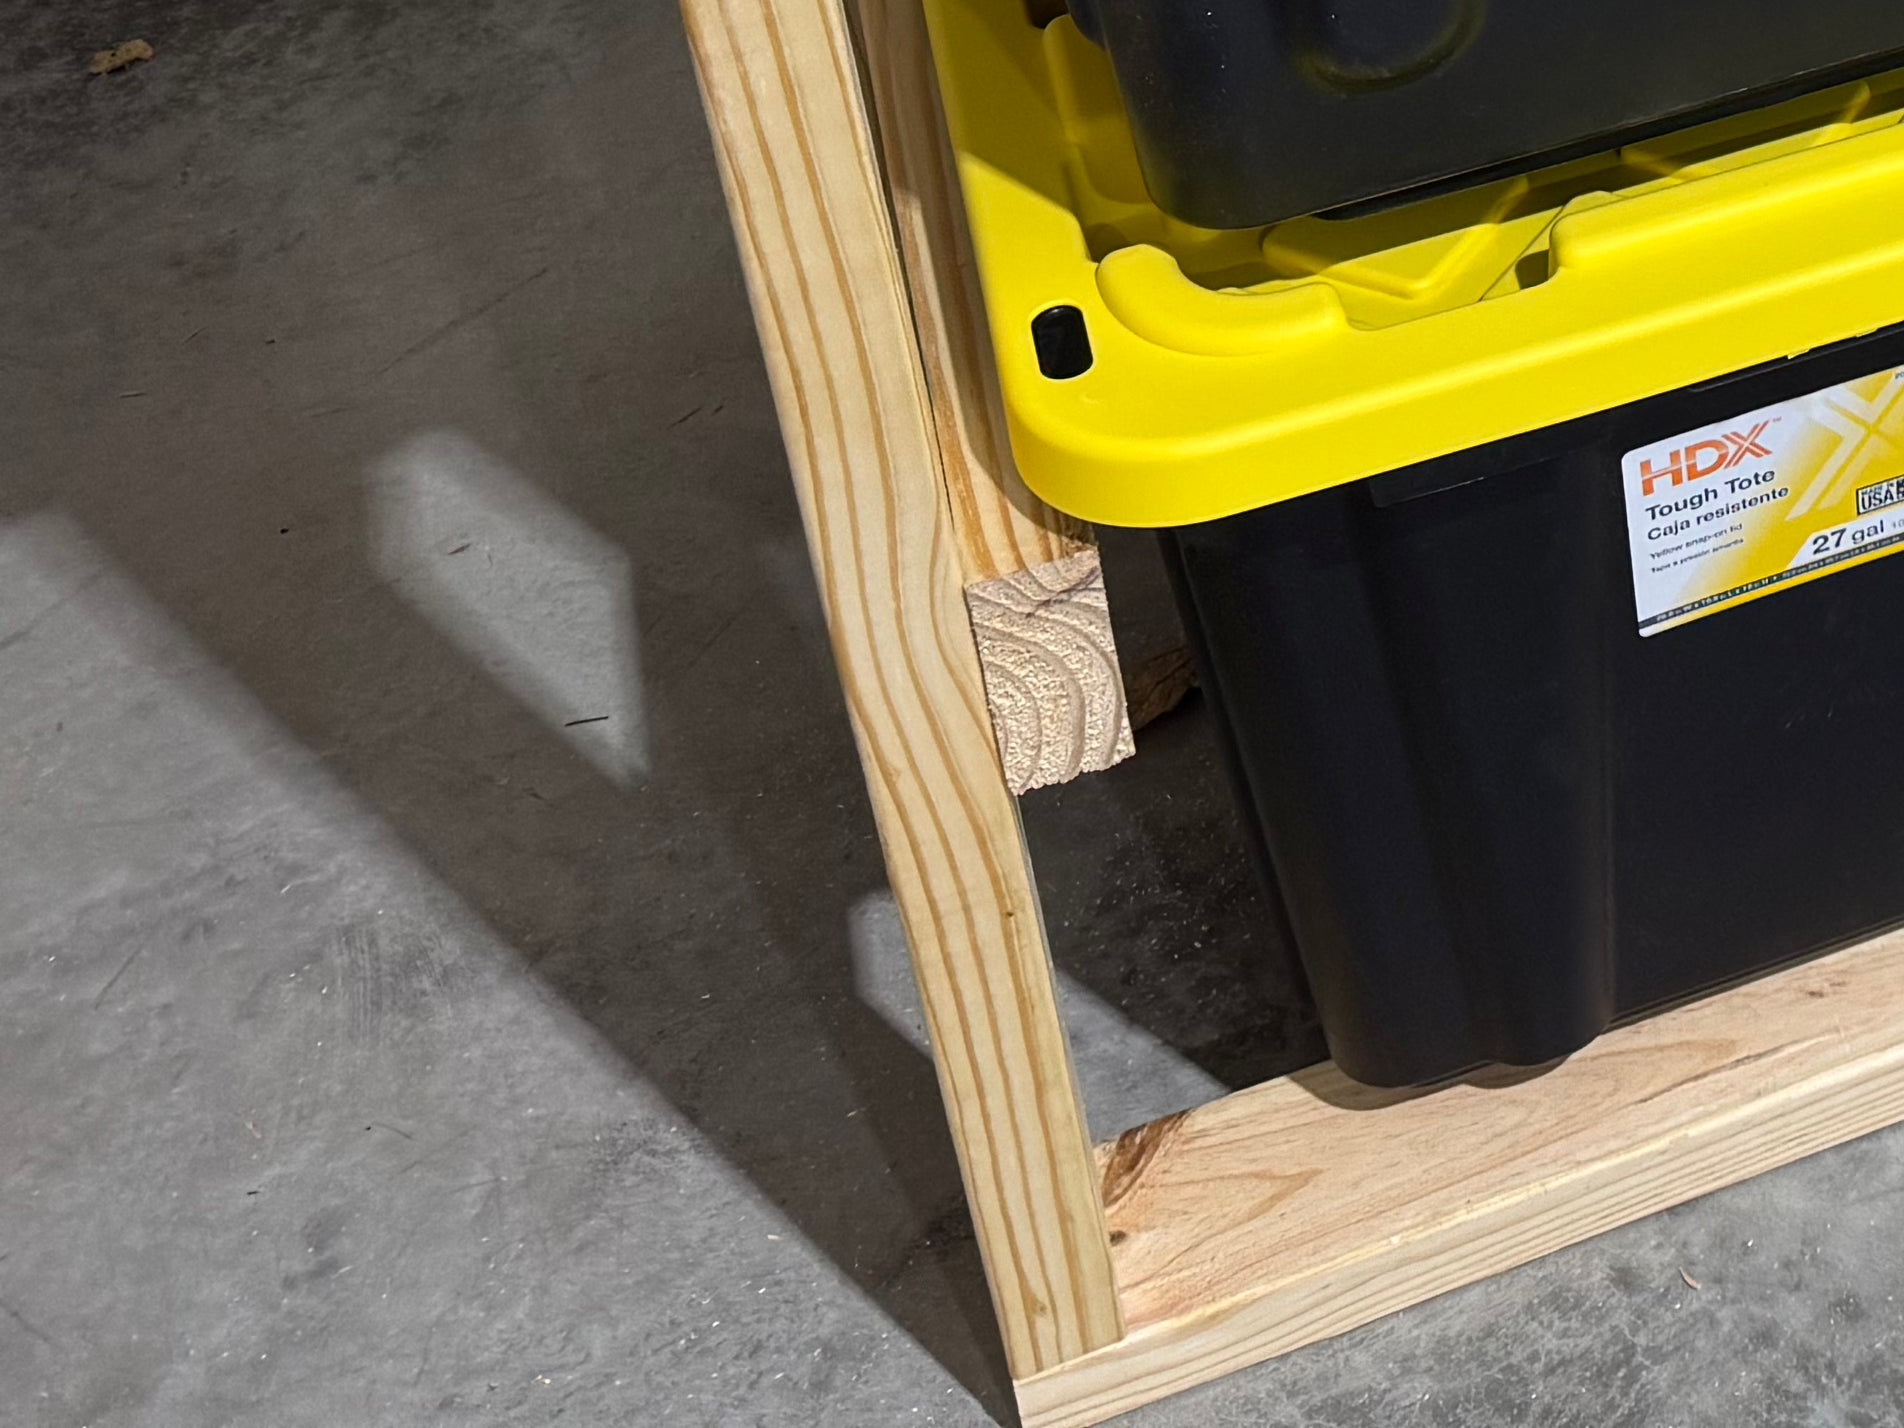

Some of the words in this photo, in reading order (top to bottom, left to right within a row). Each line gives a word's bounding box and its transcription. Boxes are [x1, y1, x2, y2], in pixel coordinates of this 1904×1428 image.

[1639, 419, 1772, 496] HDX
[1645, 487, 1717, 520] Tough
[1724, 470, 1775, 493] Tote
[1647, 519, 1690, 540] Caja
[1696, 487, 1788, 525] resistente
[1861, 484, 1894, 510] USA
[1812, 527, 1845, 555] 27
[1851, 519, 1884, 544] gal
